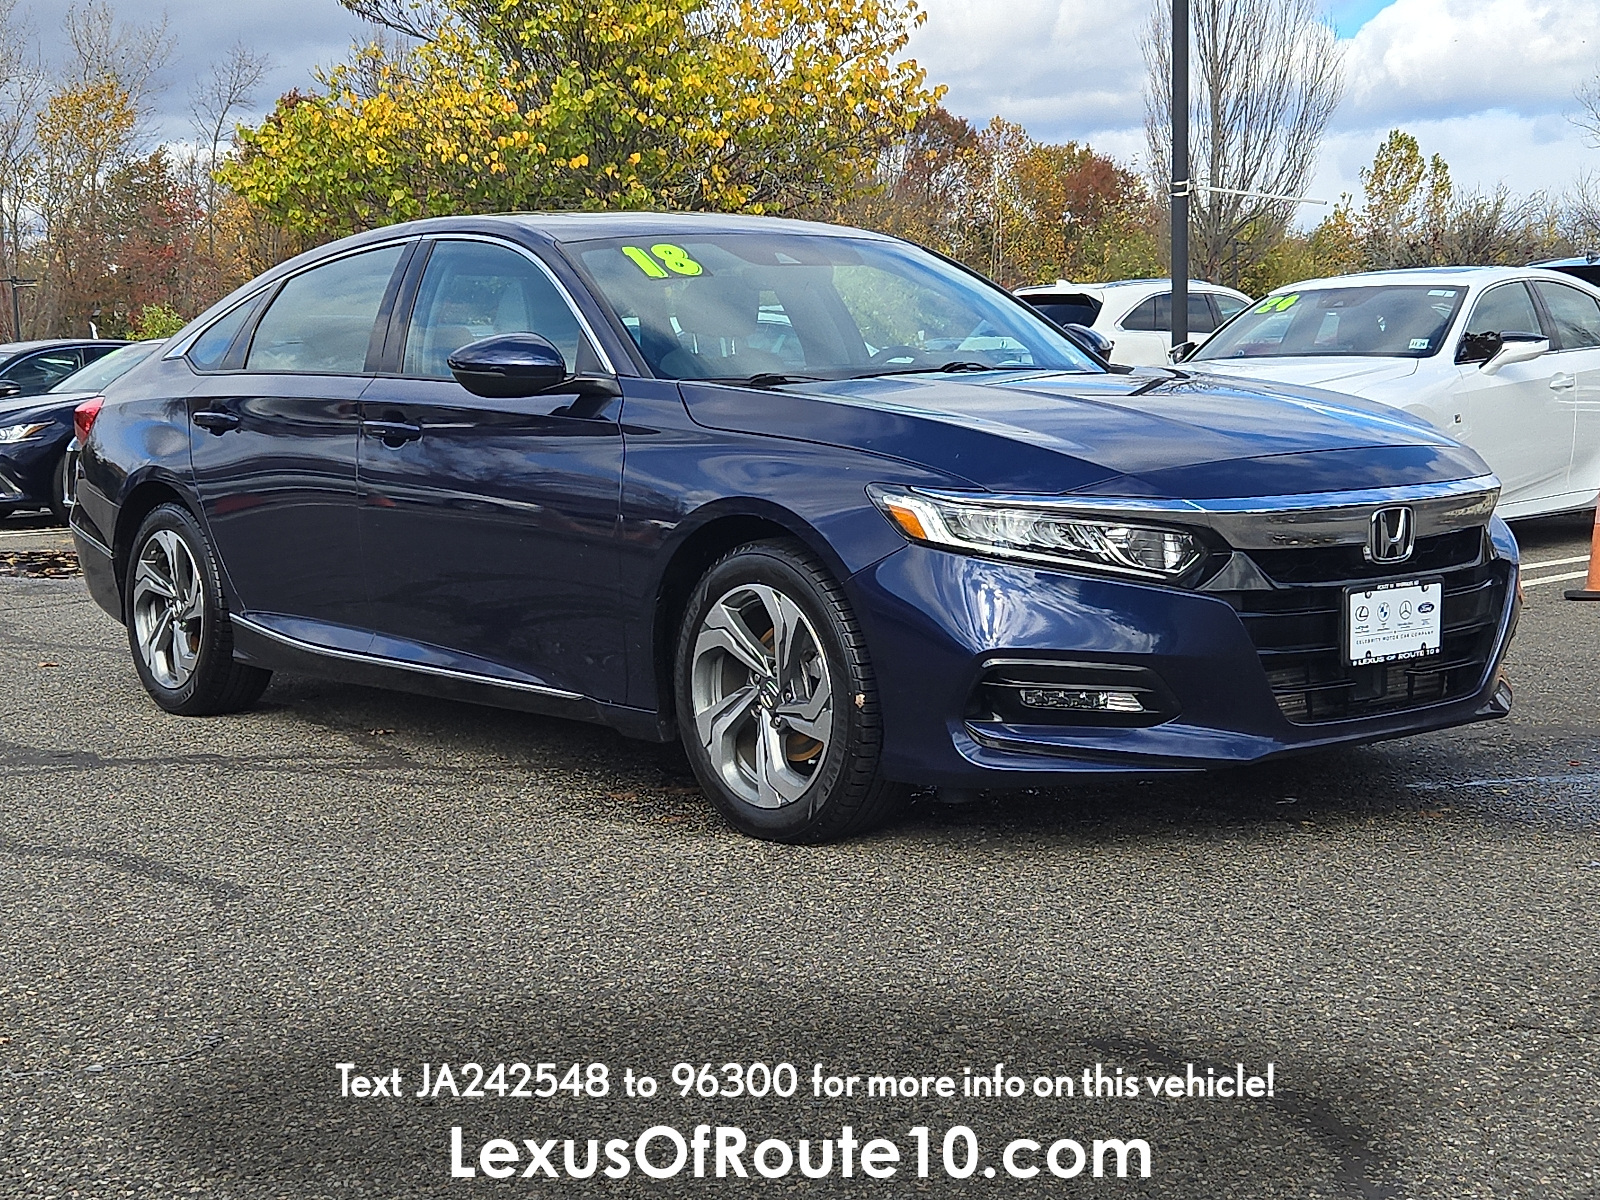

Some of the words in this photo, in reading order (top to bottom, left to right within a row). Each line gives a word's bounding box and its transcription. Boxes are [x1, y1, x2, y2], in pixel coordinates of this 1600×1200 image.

[621, 243, 703, 278] 18
[1382, 634, 1399, 642] MOTOR
[1358, 656, 1385, 666] LEXUS
[1398, 649, 1425, 660] ROUTE
